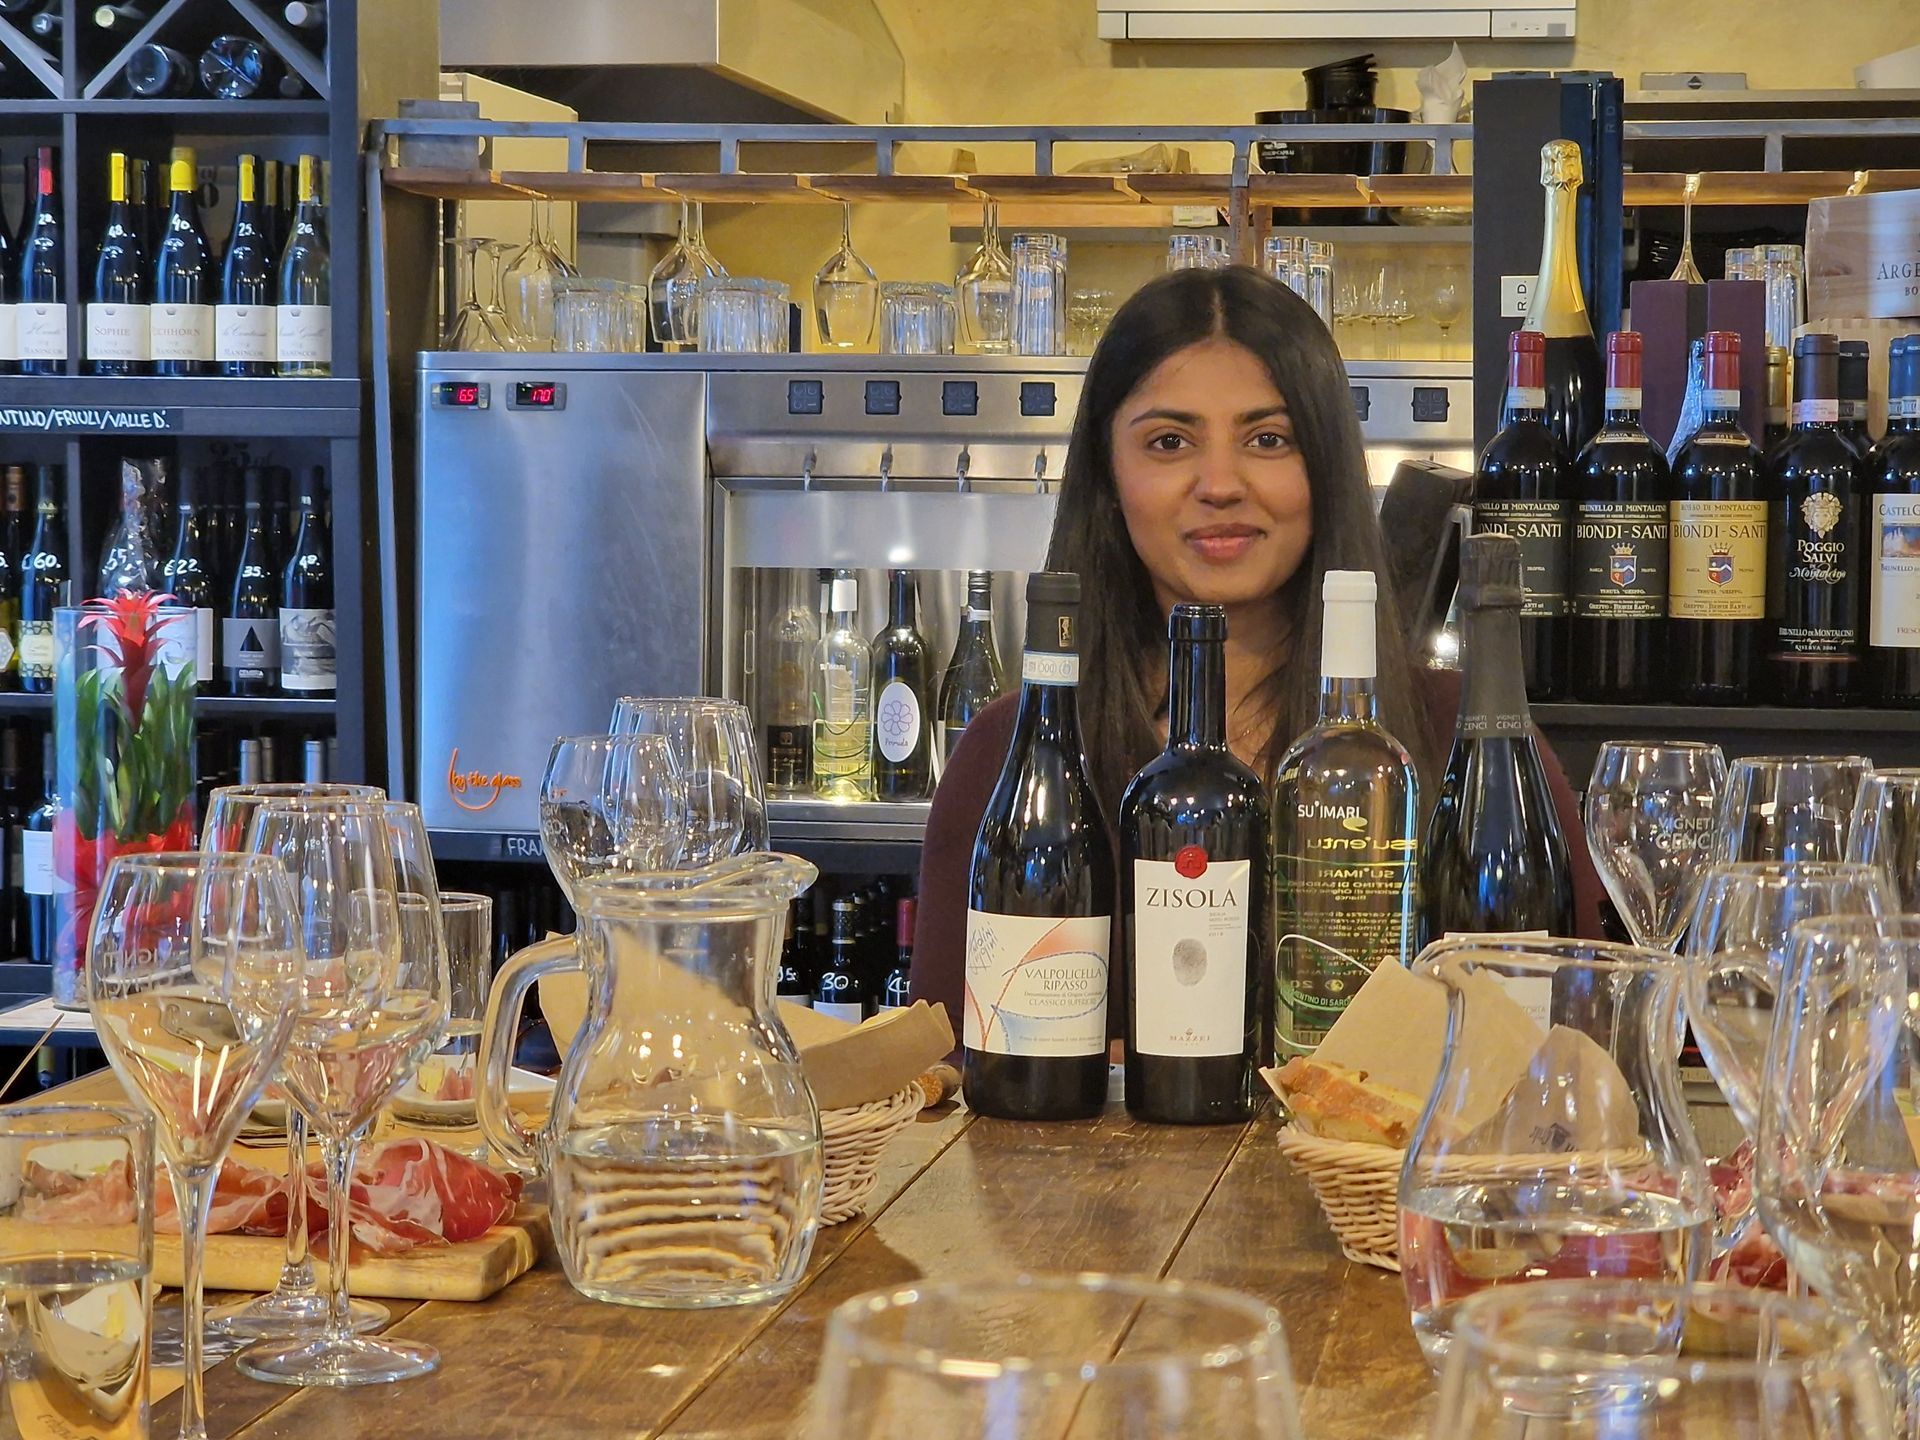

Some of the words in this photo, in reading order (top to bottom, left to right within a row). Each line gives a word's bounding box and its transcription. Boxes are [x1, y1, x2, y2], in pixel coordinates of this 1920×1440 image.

[1797, 539, 1846, 553] POGGIO
[1802, 550, 1838, 564] SALVI
[1495, 720, 1522, 729] CENCI
[1658, 815, 1715, 832] VIGNETI
[1655, 832, 1715, 851] CENCI
[1146, 887, 1238, 909] ZISOLA
[1024, 967, 1102, 980] VALPOLICELLA
[1043, 979, 1089, 991] RIPASSO
